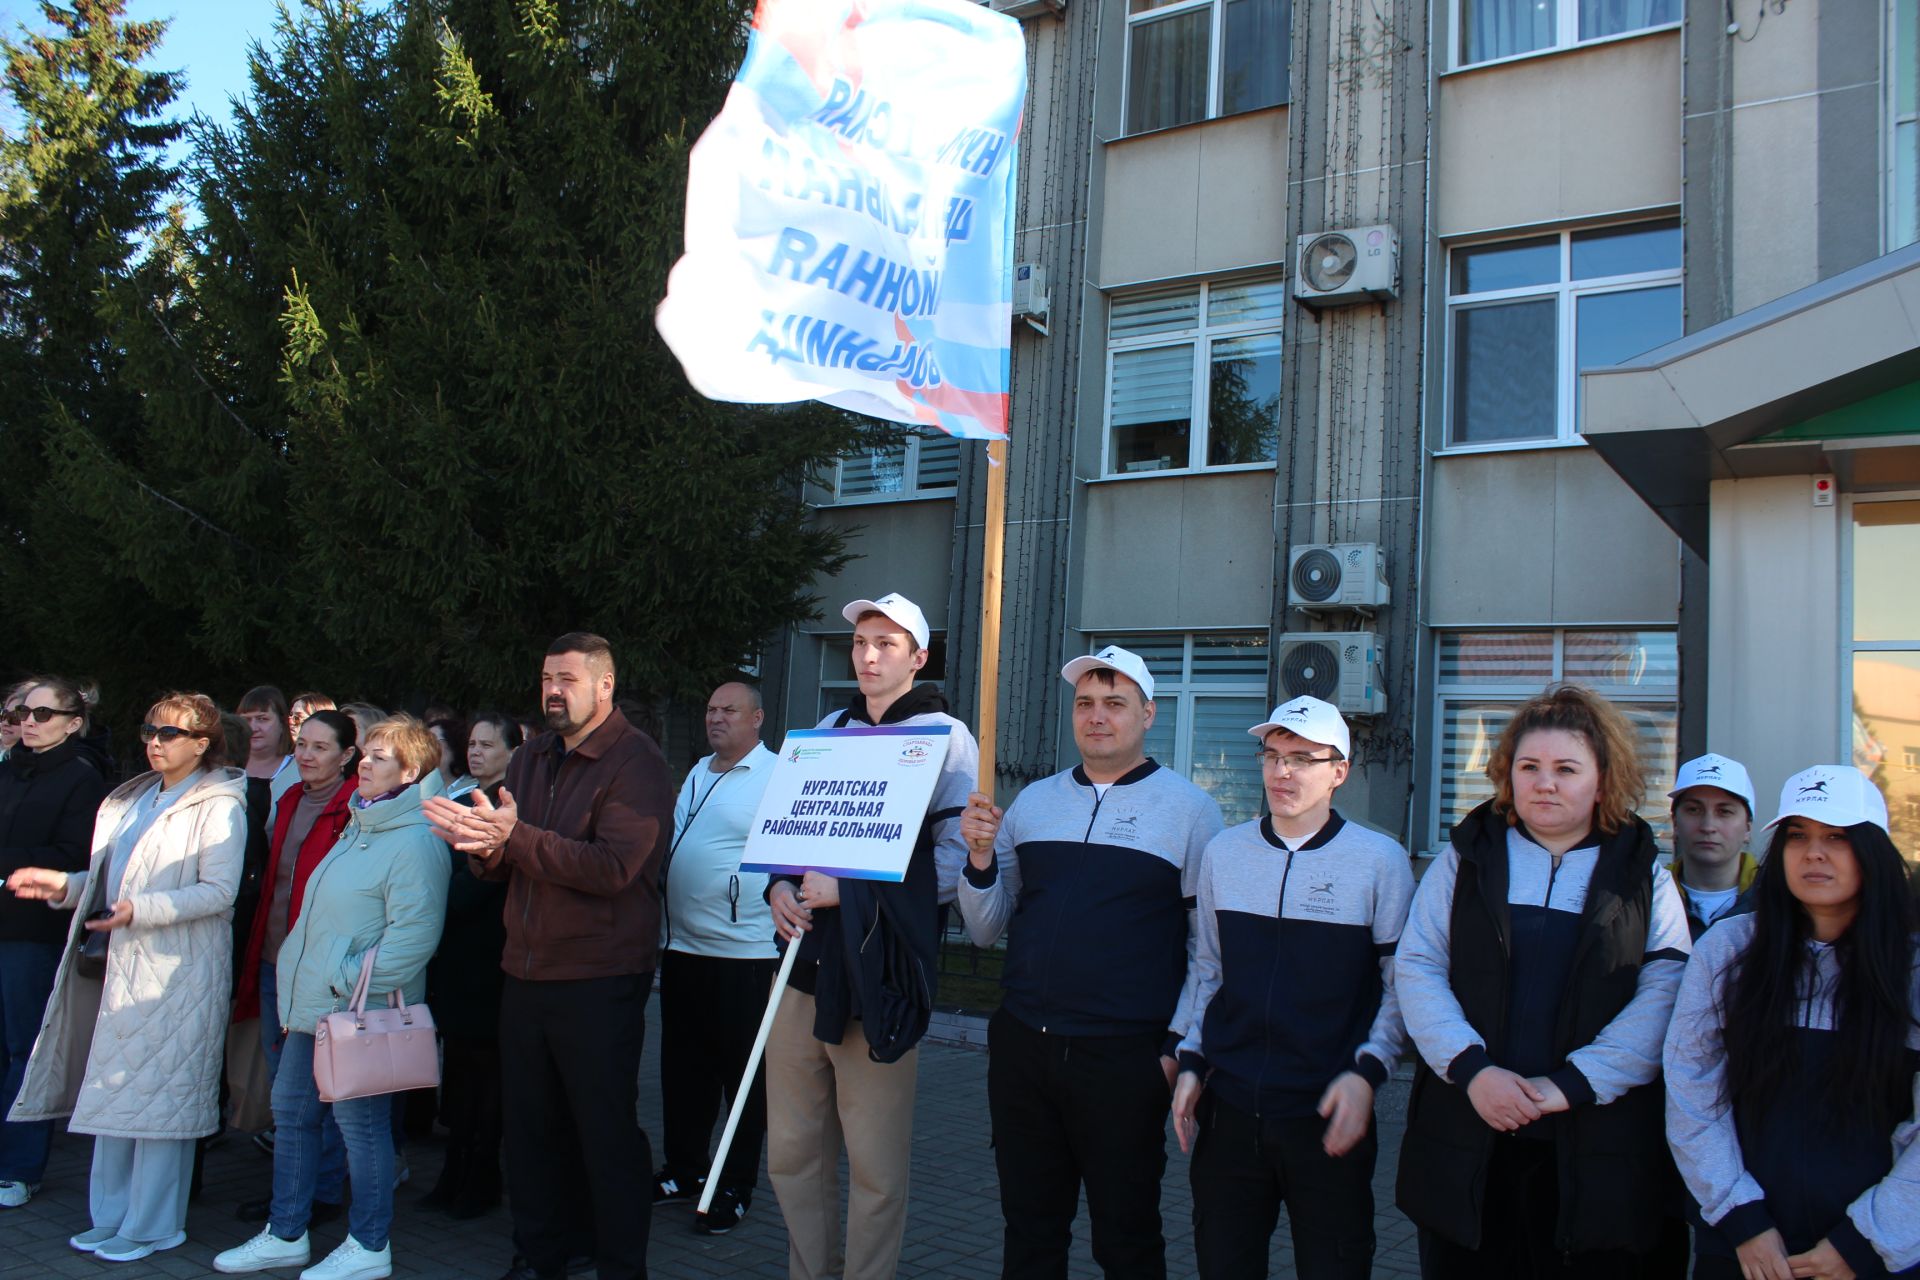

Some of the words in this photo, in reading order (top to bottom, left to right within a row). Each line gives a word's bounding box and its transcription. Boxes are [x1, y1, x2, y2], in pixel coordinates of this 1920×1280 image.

[1367, 248, 1381, 257] LG
[801, 780, 888, 797] НУРЛАТСКАЯ
[790, 799, 885, 818] ЦЕНТРАЛЬНАЯ
[761, 816, 828, 837] РАЙОННАЯ
[828, 821, 903, 842] БОЛЬНИЦА
[660, 1179, 679, 1195] N
